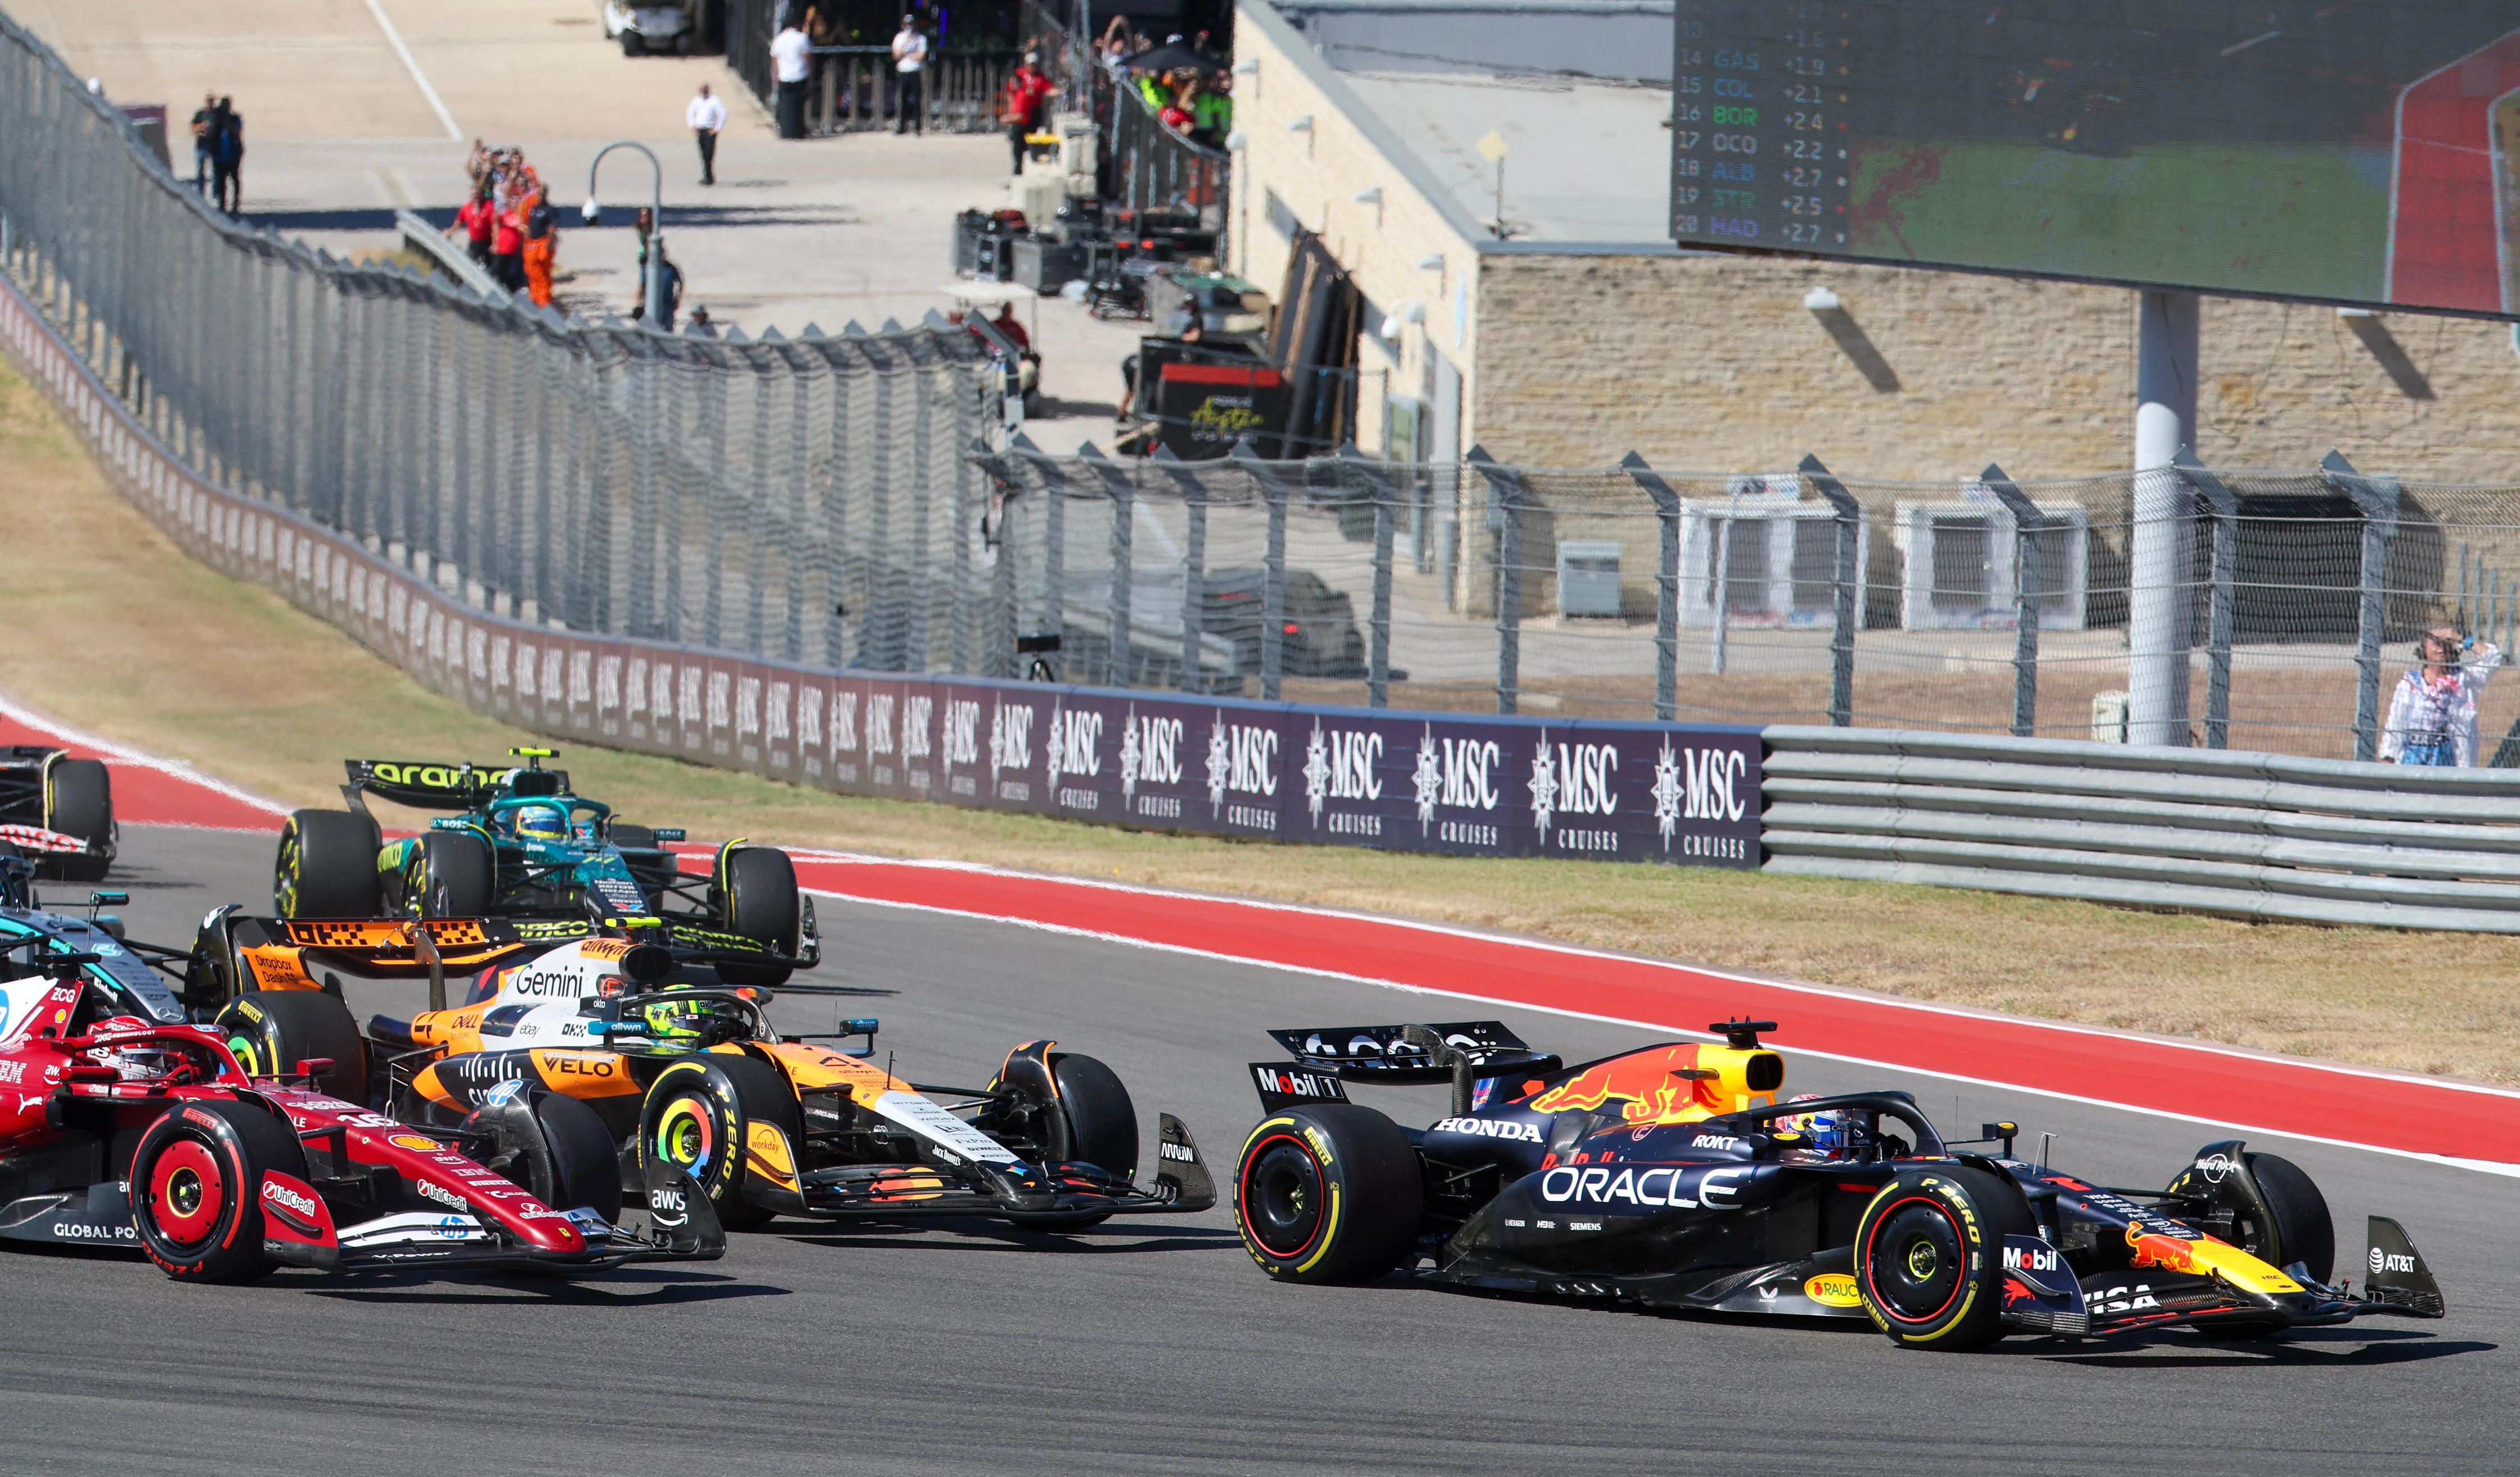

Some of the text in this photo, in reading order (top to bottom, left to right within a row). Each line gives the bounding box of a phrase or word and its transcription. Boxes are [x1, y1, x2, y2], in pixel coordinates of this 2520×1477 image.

[1714, 50, 1760, 70] GAS
[1681, 76, 1702, 94] 15
[1714, 79, 1754, 98] COL
[1679, 103, 1701, 121] 16
[1713, 105, 1758, 126] BOR
[1678, 131, 1701, 150] 17
[1712, 133, 1757, 154] OCO
[1678, 158, 1700, 177] 18
[1712, 161, 1755, 181] ALB
[1678, 185, 1699, 204] 19
[1712, 188, 1755, 209] STR
[1675, 214, 1699, 233] 20
[1710, 216, 1759, 238] HAD
[1062, 709, 1103, 777] MSC
[1140, 715, 1183, 785] MSC
[1229, 724, 1278, 796] MSC
[1330, 730, 1383, 801] MSC
[1441, 737, 1500, 810] MSC
[1558, 742, 1618, 815] MSC
[1683, 747, 1746, 822] MSC
[1138, 794, 1181, 819] CRUISES
[1228, 804, 1277, 831] CRUISES
[1328, 812, 1382, 836] CRUISES
[1440, 820, 1498, 846] CRUISES
[1558, 828, 1618, 853] CRUISES
[1683, 834, 1746, 860] CRUISES
[581, 938, 625, 960] allwyn
[256, 954, 294, 972] Dropbox
[263, 969, 287, 984] Dash
[516, 963, 584, 999] Gemini
[51, 987, 76, 1004] ZCG
[593, 999, 606, 1009] okta
[238, 1000, 264, 1024] PIRELLI
[451, 1014, 479, 1029] DELL
[94, 1029, 156, 1043] DXC TECHNOLOGY
[519, 1022, 541, 1038] ebay
[610, 1022, 642, 1033] allwyn
[0, 1059, 28, 1084] BM
[45, 1064, 61, 1077] aw
[542, 1056, 614, 1078] VELO
[1256, 1066, 1320, 1097] Mobil
[181, 1107, 220, 1130] PIRELLI
[336, 1114, 400, 1128] 16
[813, 1109, 842, 1121] McLaren
[716, 1090, 737, 1181] P ZERO
[1433, 1117, 1543, 1143] HONDA
[751, 1140, 780, 1154] workday
[932, 1144, 945, 1159] JACK
[1303, 1125, 1334, 1167] PIRELLI
[1692, 1134, 1739, 1151] ROKT
[431, 1154, 462, 1163] aws
[2195, 1159, 2236, 1173] Hard Rock
[450, 1168, 493, 1177] IBM
[428, 1182, 468, 1212] UniCredit
[1542, 1166, 1743, 1210] ORACLE
[275, 1185, 315, 1217] UniCredit
[651, 1189, 686, 1211] aws
[1920, 1177, 1981, 1244] P ZERO
[54, 1223, 112, 1239] GLOBAL
[1508, 1219, 1526, 1228] HEXAGON
[1570, 1222, 1602, 1231] SIEMENS
[1234, 1207, 1266, 1265] ZERO
[140, 1240, 203, 1275] P ZERO
[372, 1251, 451, 1259] V-Power
[2003, 1246, 2057, 1271] Mobil
[2384, 1253, 2415, 1273] AT&T
[1824, 1282, 1859, 1297] RAUC
[1861, 1292, 1890, 1333] PIRELLI
